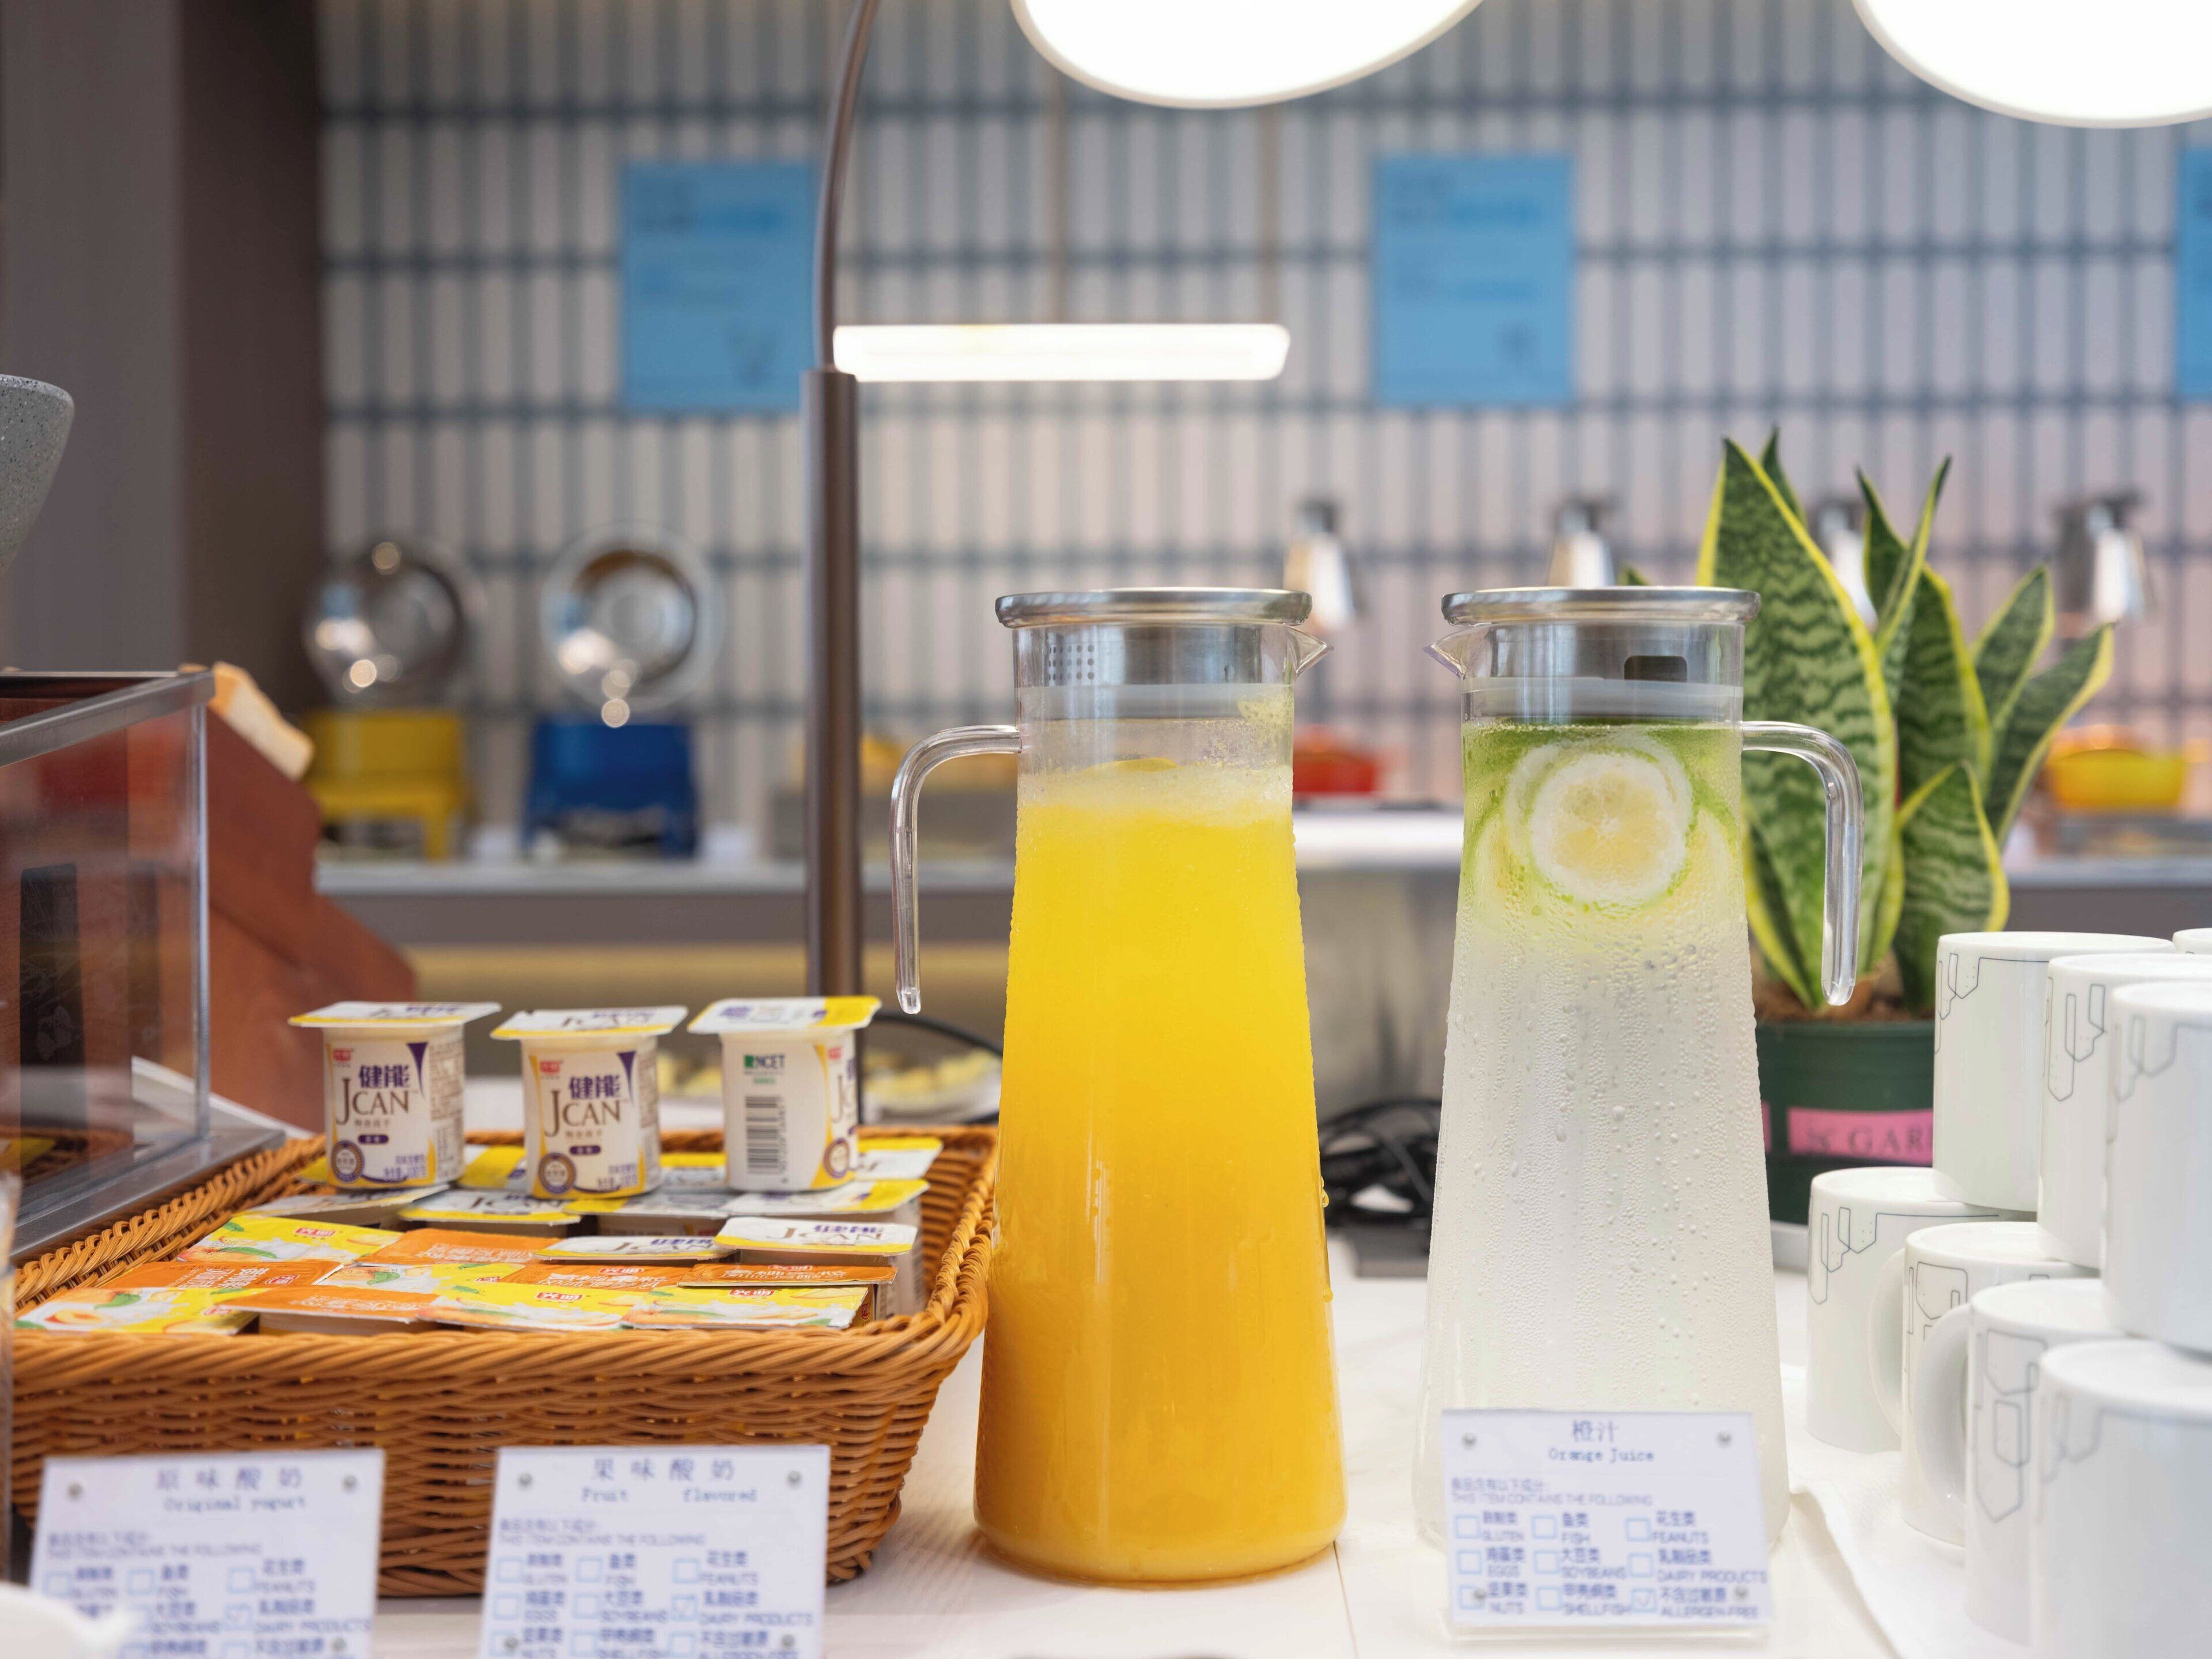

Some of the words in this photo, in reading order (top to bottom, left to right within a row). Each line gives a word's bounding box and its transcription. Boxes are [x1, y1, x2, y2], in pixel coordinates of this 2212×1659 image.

[359, 1065, 408, 1088] 健能
[569, 1075, 620, 1099] 健能
[336, 1078, 409, 1125] JCAN
[543, 1090, 621, 1137] JCAN
[1573, 1421, 1619, 1442] 橙汁
[1548, 1448, 1603, 1463] Orange
[1610, 1448, 1655, 1463] Juice
[594, 1459, 735, 1481] 果味酸奶
[164, 1497, 241, 1513] Original
[582, 1488, 629, 1502] Fruit
[683, 1487, 758, 1503] flavored
